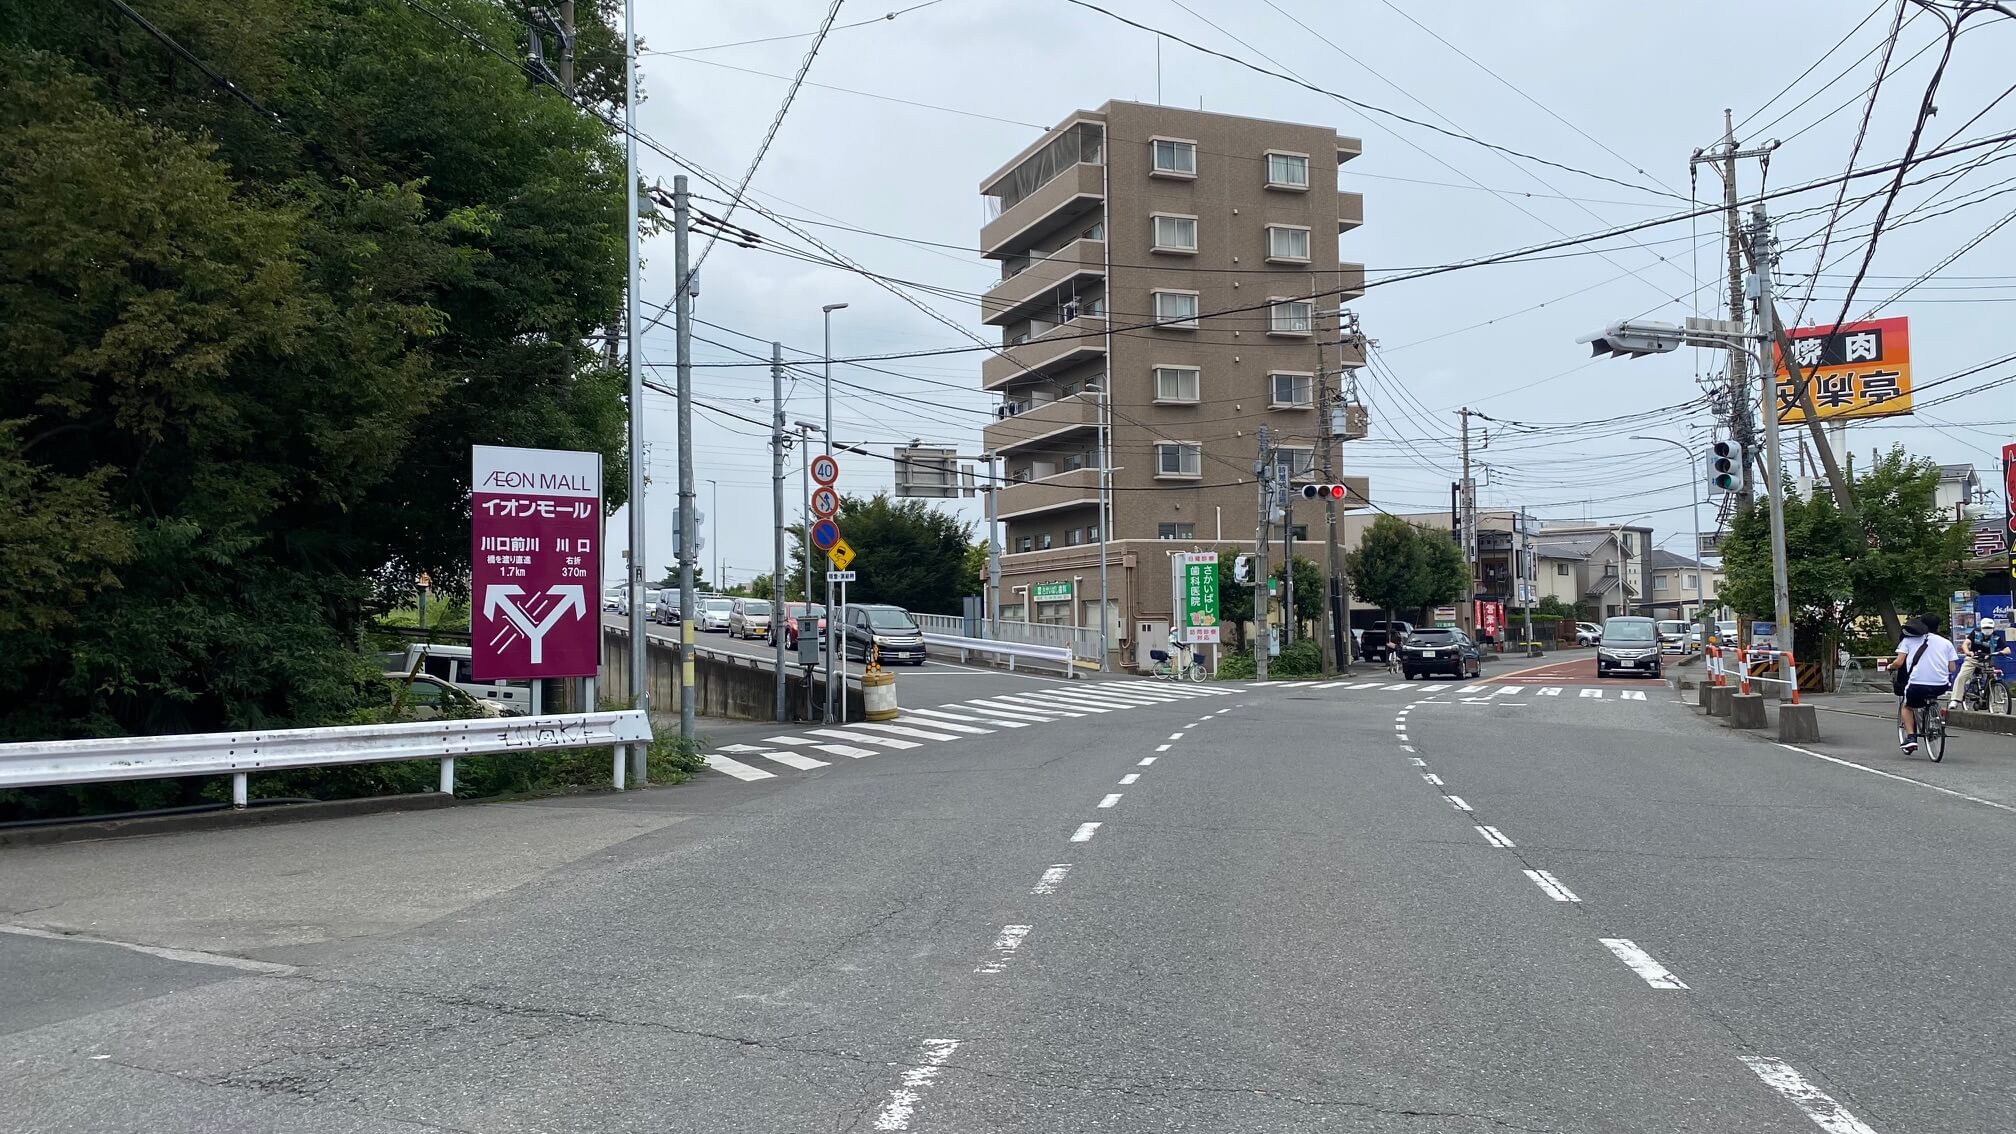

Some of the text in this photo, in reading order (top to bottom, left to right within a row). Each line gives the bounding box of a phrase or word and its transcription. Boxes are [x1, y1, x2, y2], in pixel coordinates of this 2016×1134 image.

[818, 464, 832, 477] 40
[540, 473, 591, 491] MALL
[482, 499, 591, 519] イオンモール
[481, 536, 539, 552] 川口前川
[487, 555, 531, 565] 橋を渡り直進
[565, 556, 581, 565] 右折
[500, 566, 526, 577] 1.7km
[562, 567, 587, 577] 370m
[1190, 565, 1200, 607] 歯科医院
[1203, 565, 1213, 613] さかいばし
[1485, 604, 1495, 635] 営業中
